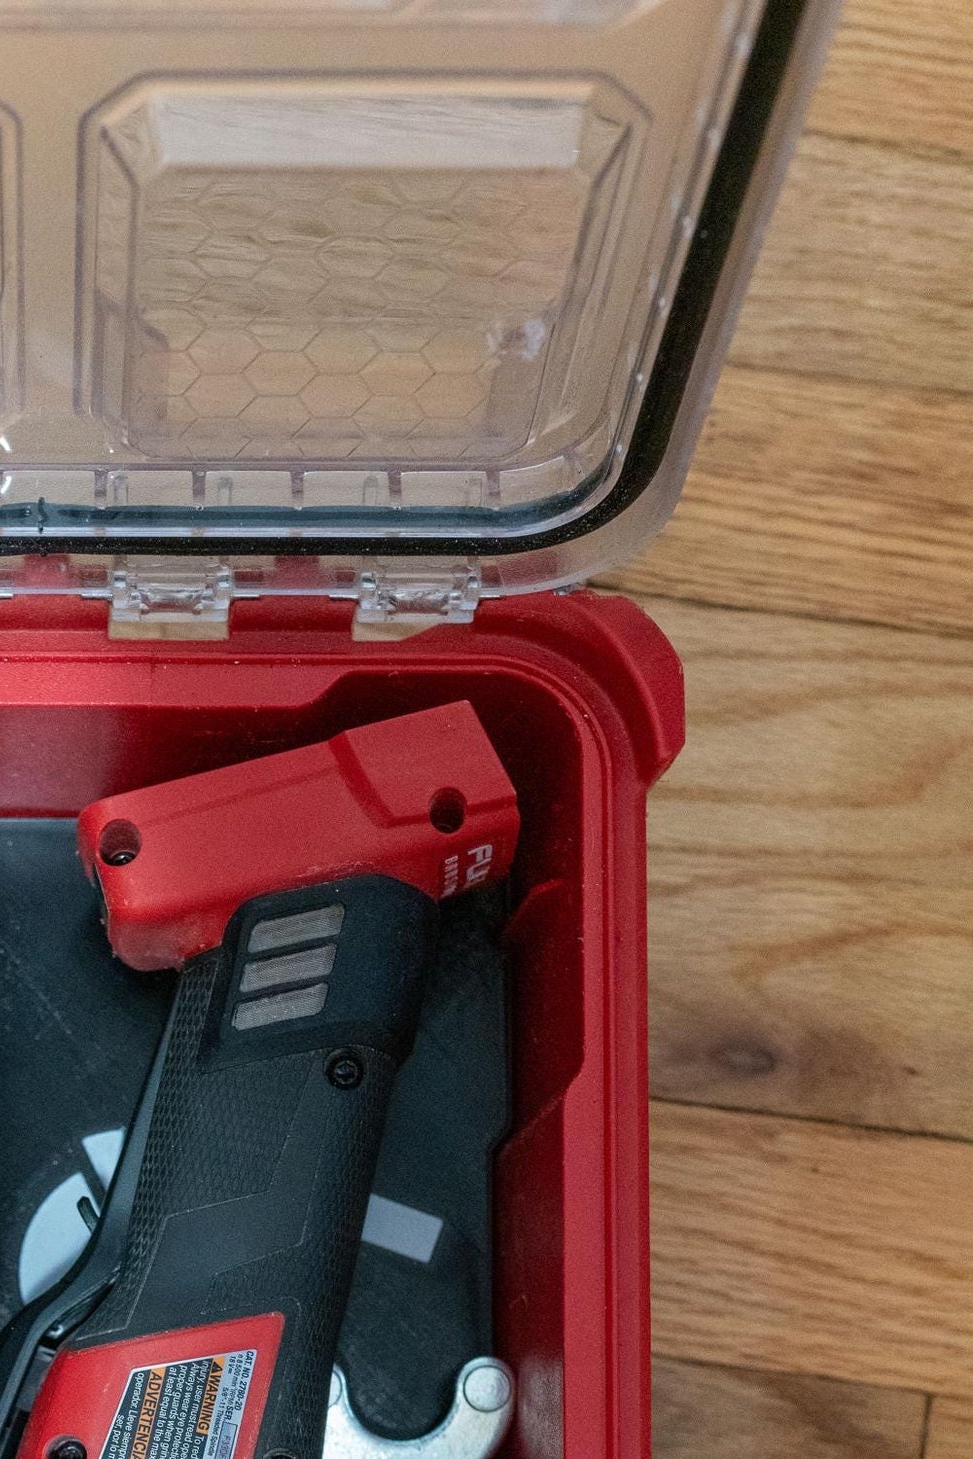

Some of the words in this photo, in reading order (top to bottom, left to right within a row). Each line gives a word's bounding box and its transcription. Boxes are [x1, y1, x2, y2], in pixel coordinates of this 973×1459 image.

[243, 1350, 254, 1366] CAT.
[168, 1366, 178, 1376] at
[172, 1363, 188, 1391] proper
[183, 1361, 200, 1392] Always
[195, 1359, 210, 1385] injury,
[240, 1366, 251, 1380] NO.
[126, 1370, 146, 1410] operador.
[163, 1375, 176, 1397] least
[191, 1383, 205, 1406] user
[156, 1395, 171, 1419] equal
[166, 1390, 183, 1420] guards
[180, 1390, 192, 1412] wear
[196, 1373, 222, 1432] WARNING
[113, 1413, 124, 1430] ser,
[123, 1408, 138, 1432] Lleve
[155, 1418, 166, 1428] to
[175, 1410, 187, 1427] eye
[187, 1405, 200, 1424] must
[109, 1428, 121, 1445] por
[152, 1427, 164, 1442] the
[163, 1419, 176, 1443] when
[183, 1422, 195, 1443] read
[193, 1433, 204, 1446] To
[108, 1443, 118, 1453] lo
